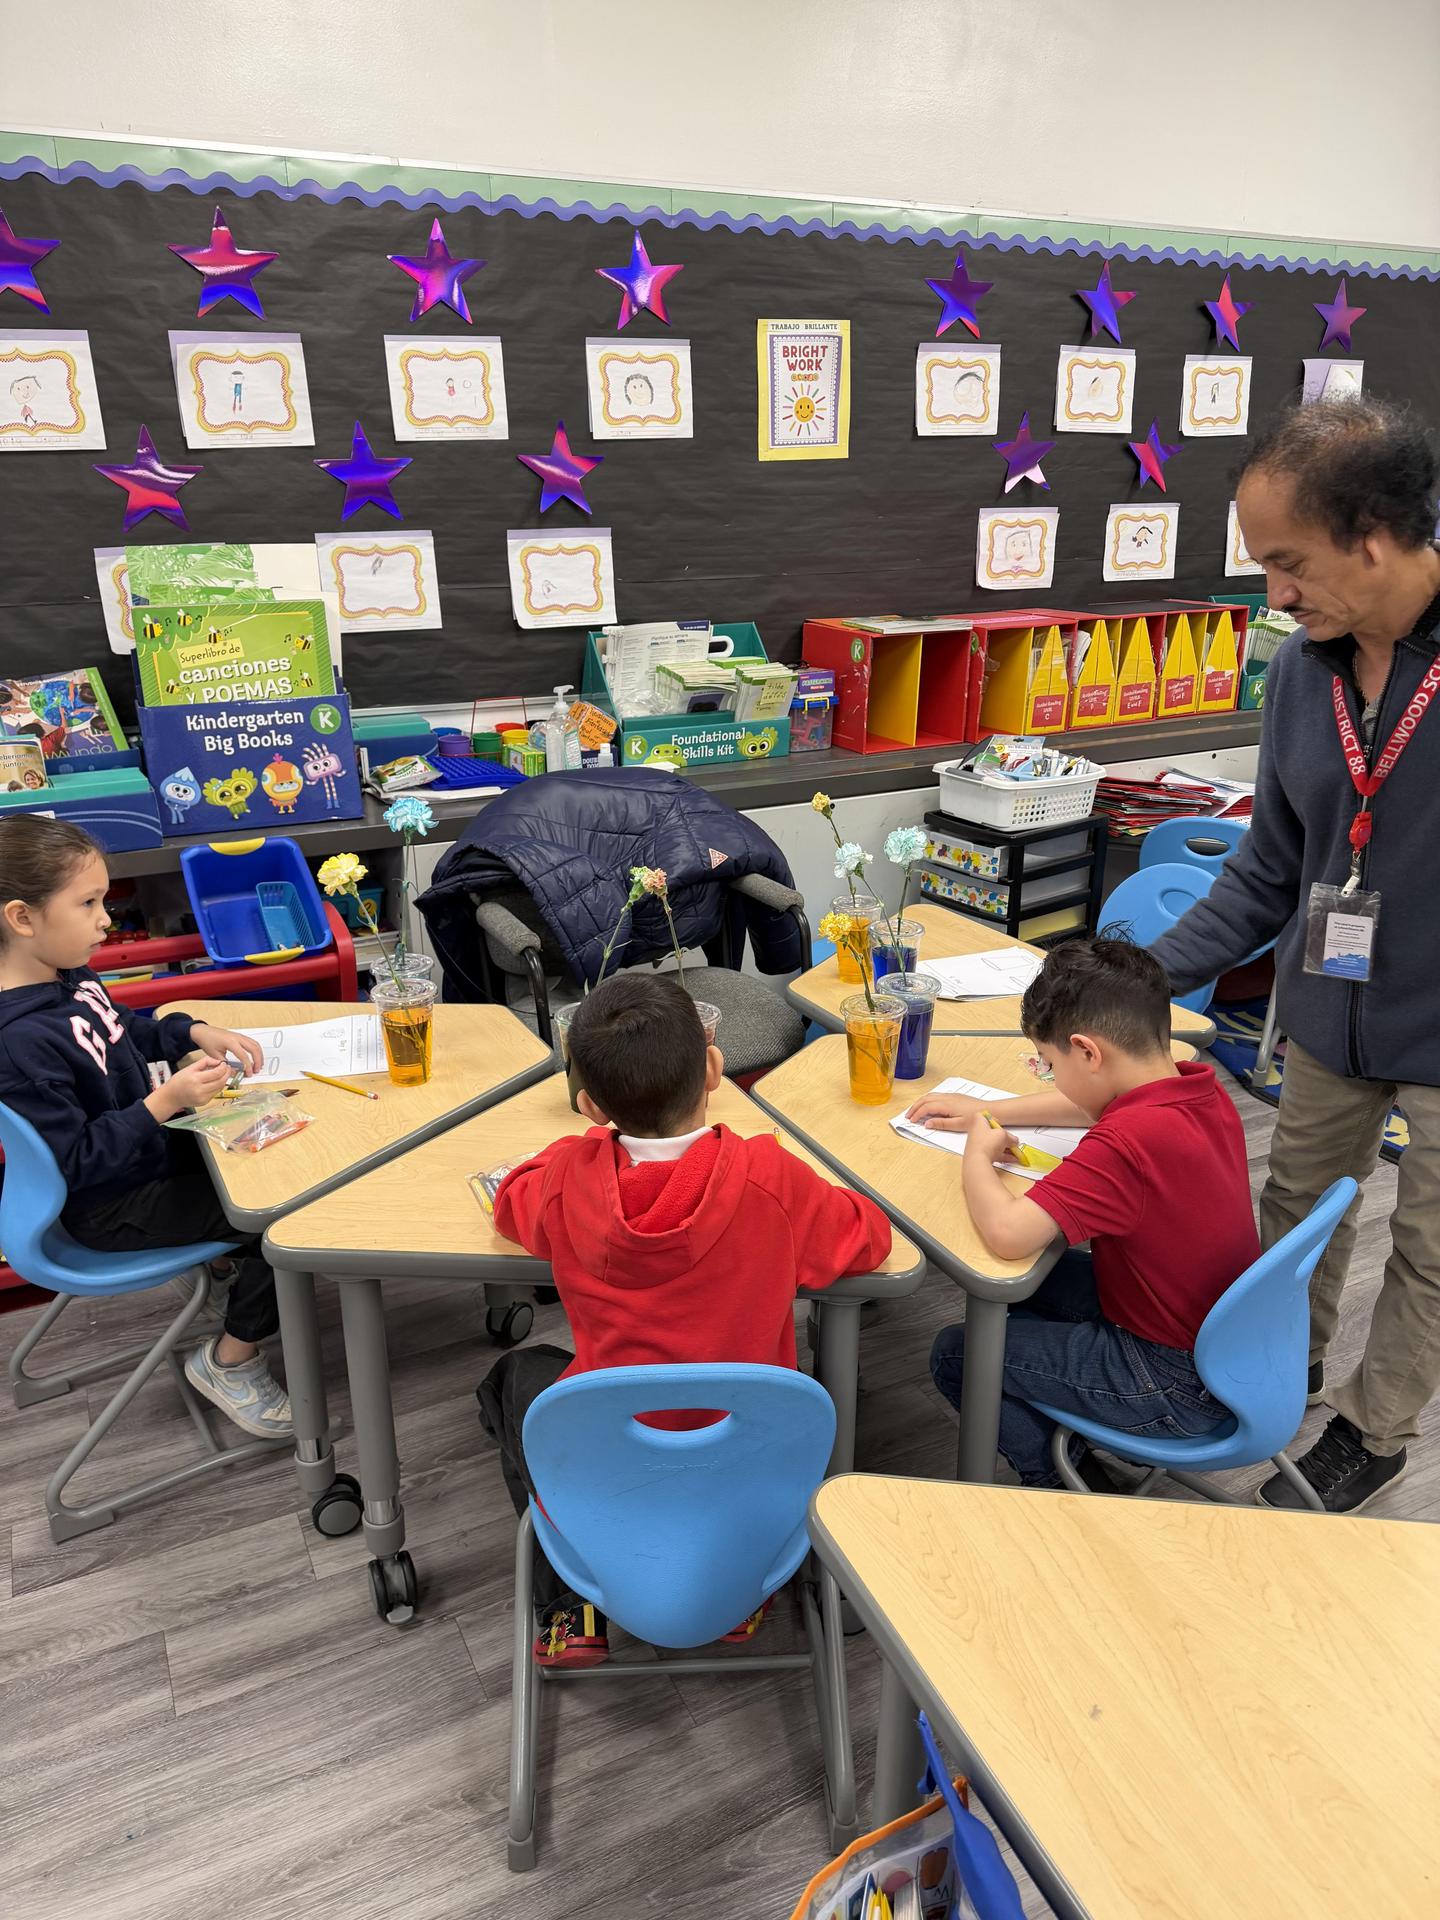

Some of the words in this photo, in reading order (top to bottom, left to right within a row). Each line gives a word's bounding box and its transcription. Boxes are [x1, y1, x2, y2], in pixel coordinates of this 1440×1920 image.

[782, 345, 828, 357] BRIGHT
[786, 359, 822, 371] WORK
[179, 649, 227, 665] Superlibro
[228, 645, 241, 656] de
[854, 644, 862, 660] K
[179, 656, 292, 684] canciones
[185, 690, 197, 704] y
[201, 676, 294, 704] POEMAS
[1253, 683, 1264, 695] K
[186, 709, 305, 732] Kindergarten
[318, 710, 335, 729] K
[671, 727, 746, 746] Foundational
[1333, 684, 1360, 752] DISTRICT
[1348, 755, 1366, 776] 88
[1374, 692, 1430, 779] BELLWOOD
[204, 734, 235, 755] Big
[237, 730, 294, 749] Books
[631, 740, 643, 756] K
[682, 745, 714, 760] Skills
[717, 744, 735, 757] Kit
